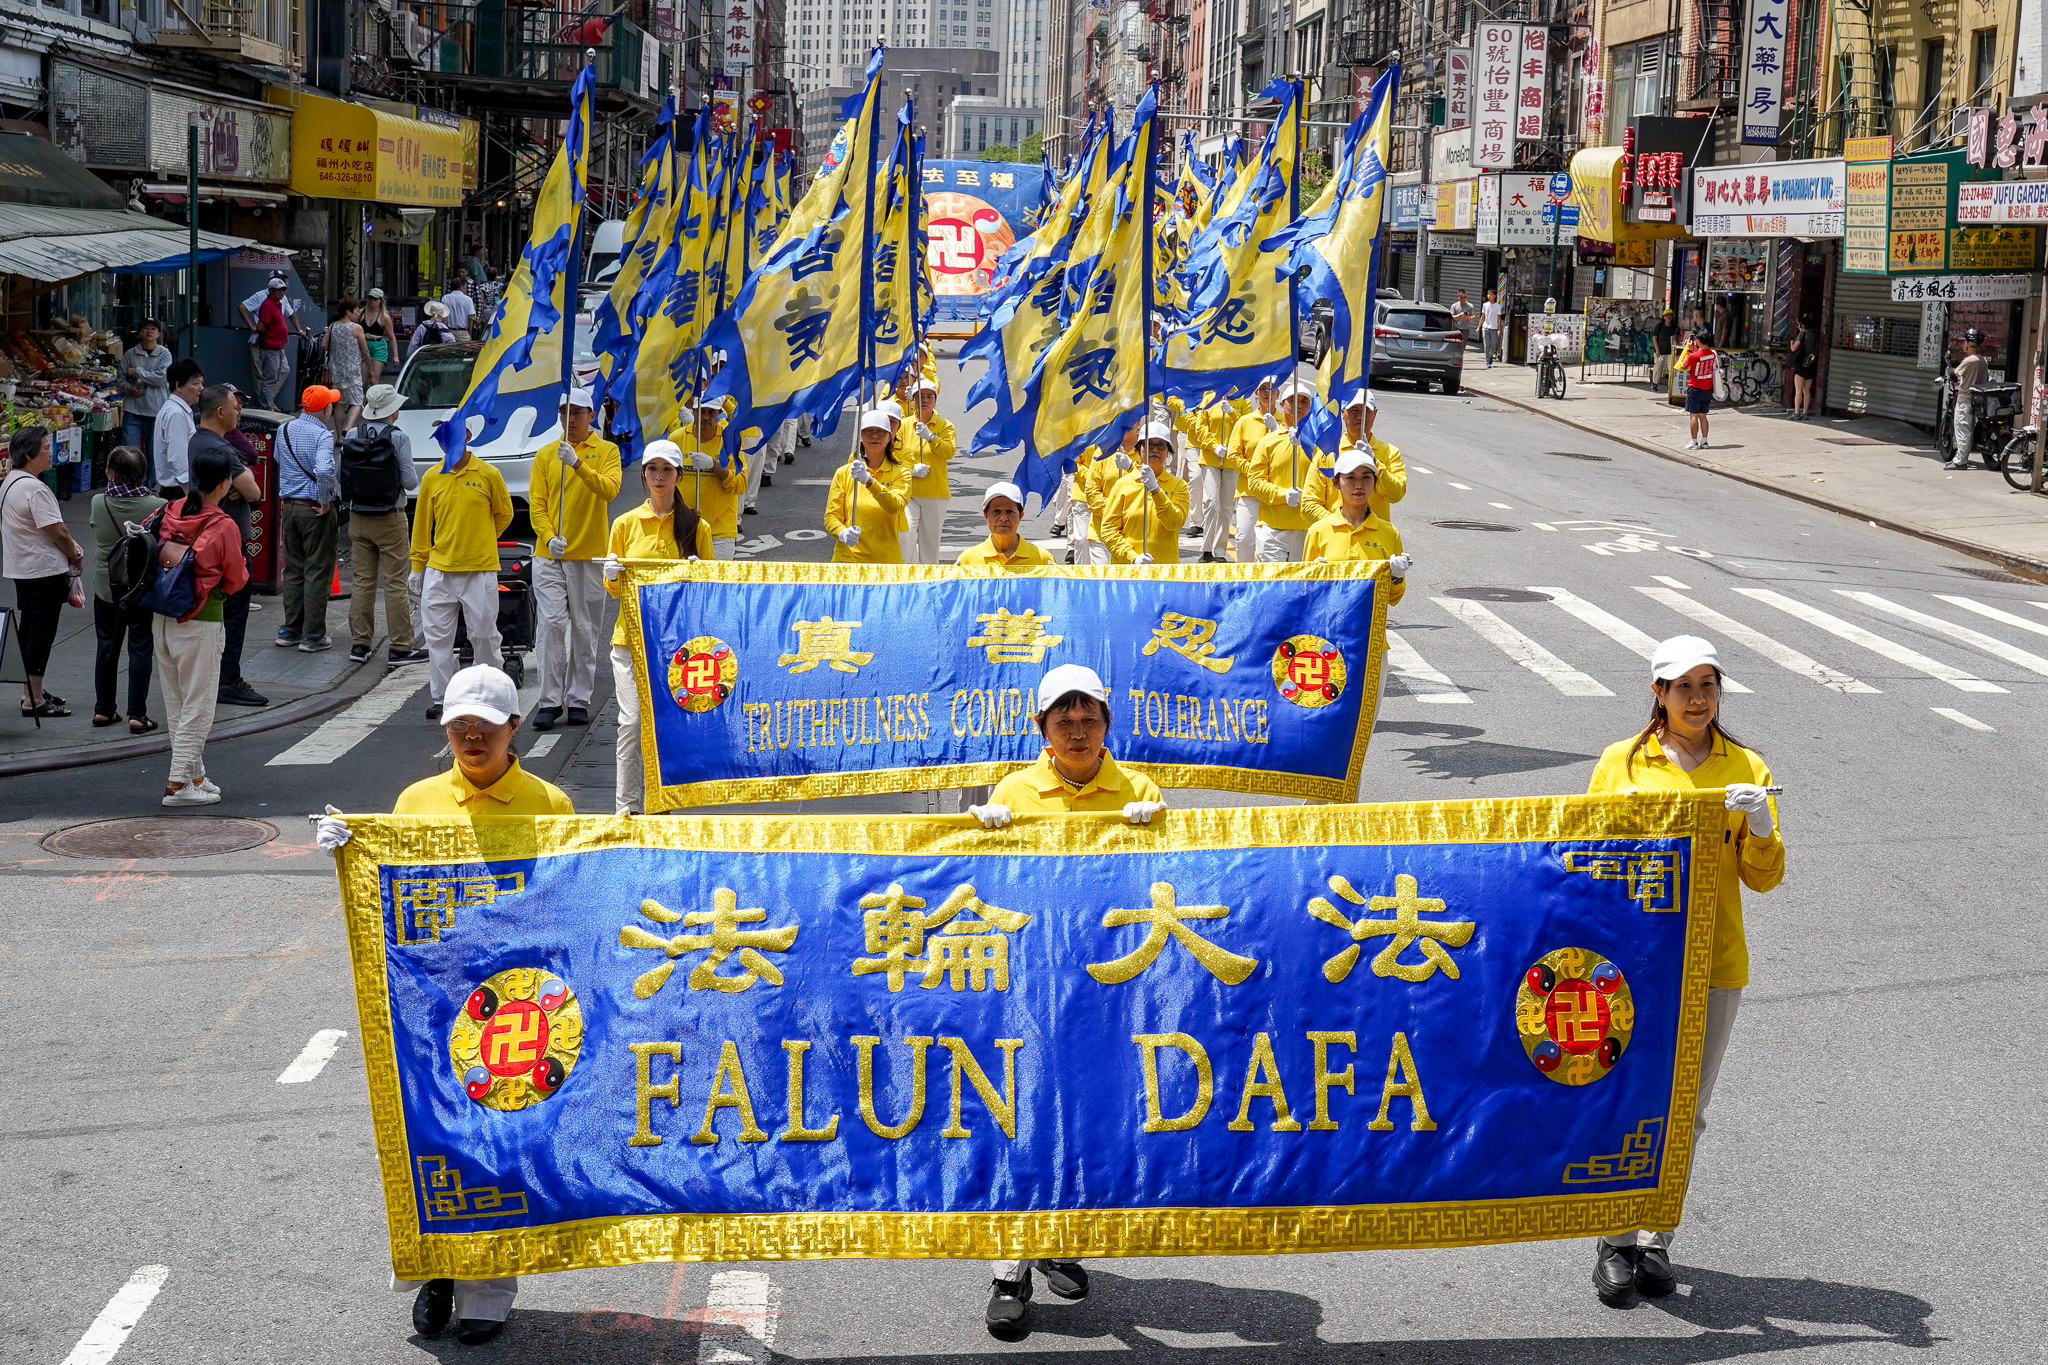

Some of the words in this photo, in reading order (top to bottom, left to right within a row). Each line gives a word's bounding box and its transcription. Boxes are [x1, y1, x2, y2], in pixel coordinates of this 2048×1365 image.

[726, 0, 752, 57] 華傢俬
[1747, 0, 1784, 114] 大藥房
[316, 157, 375, 172] 福州小吃店
[319, 171, 372, 183] 646-326-8810
[1772, 179, 1780, 201] 66
[1781, 176, 1820, 200] PHARMACY
[1820, 176, 1833, 199] INC
[1993, 185, 2015, 205] JUFU
[1543, 205, 1552, 213] M9
[1893, 246, 1941, 260] 文化流協會
[1952, 243, 1972, 251] GOLDEN
[777, 607, 1235, 674] 真善忍
[743, 692, 929, 753] TRUTHFULNESS
[1129, 688, 1269, 744] TOLERANCE
[619, 873, 1476, 1000] 法輪大法
[628, 1034, 1024, 1147] FALUN
[1132, 1030, 1437, 1133] DAFA
